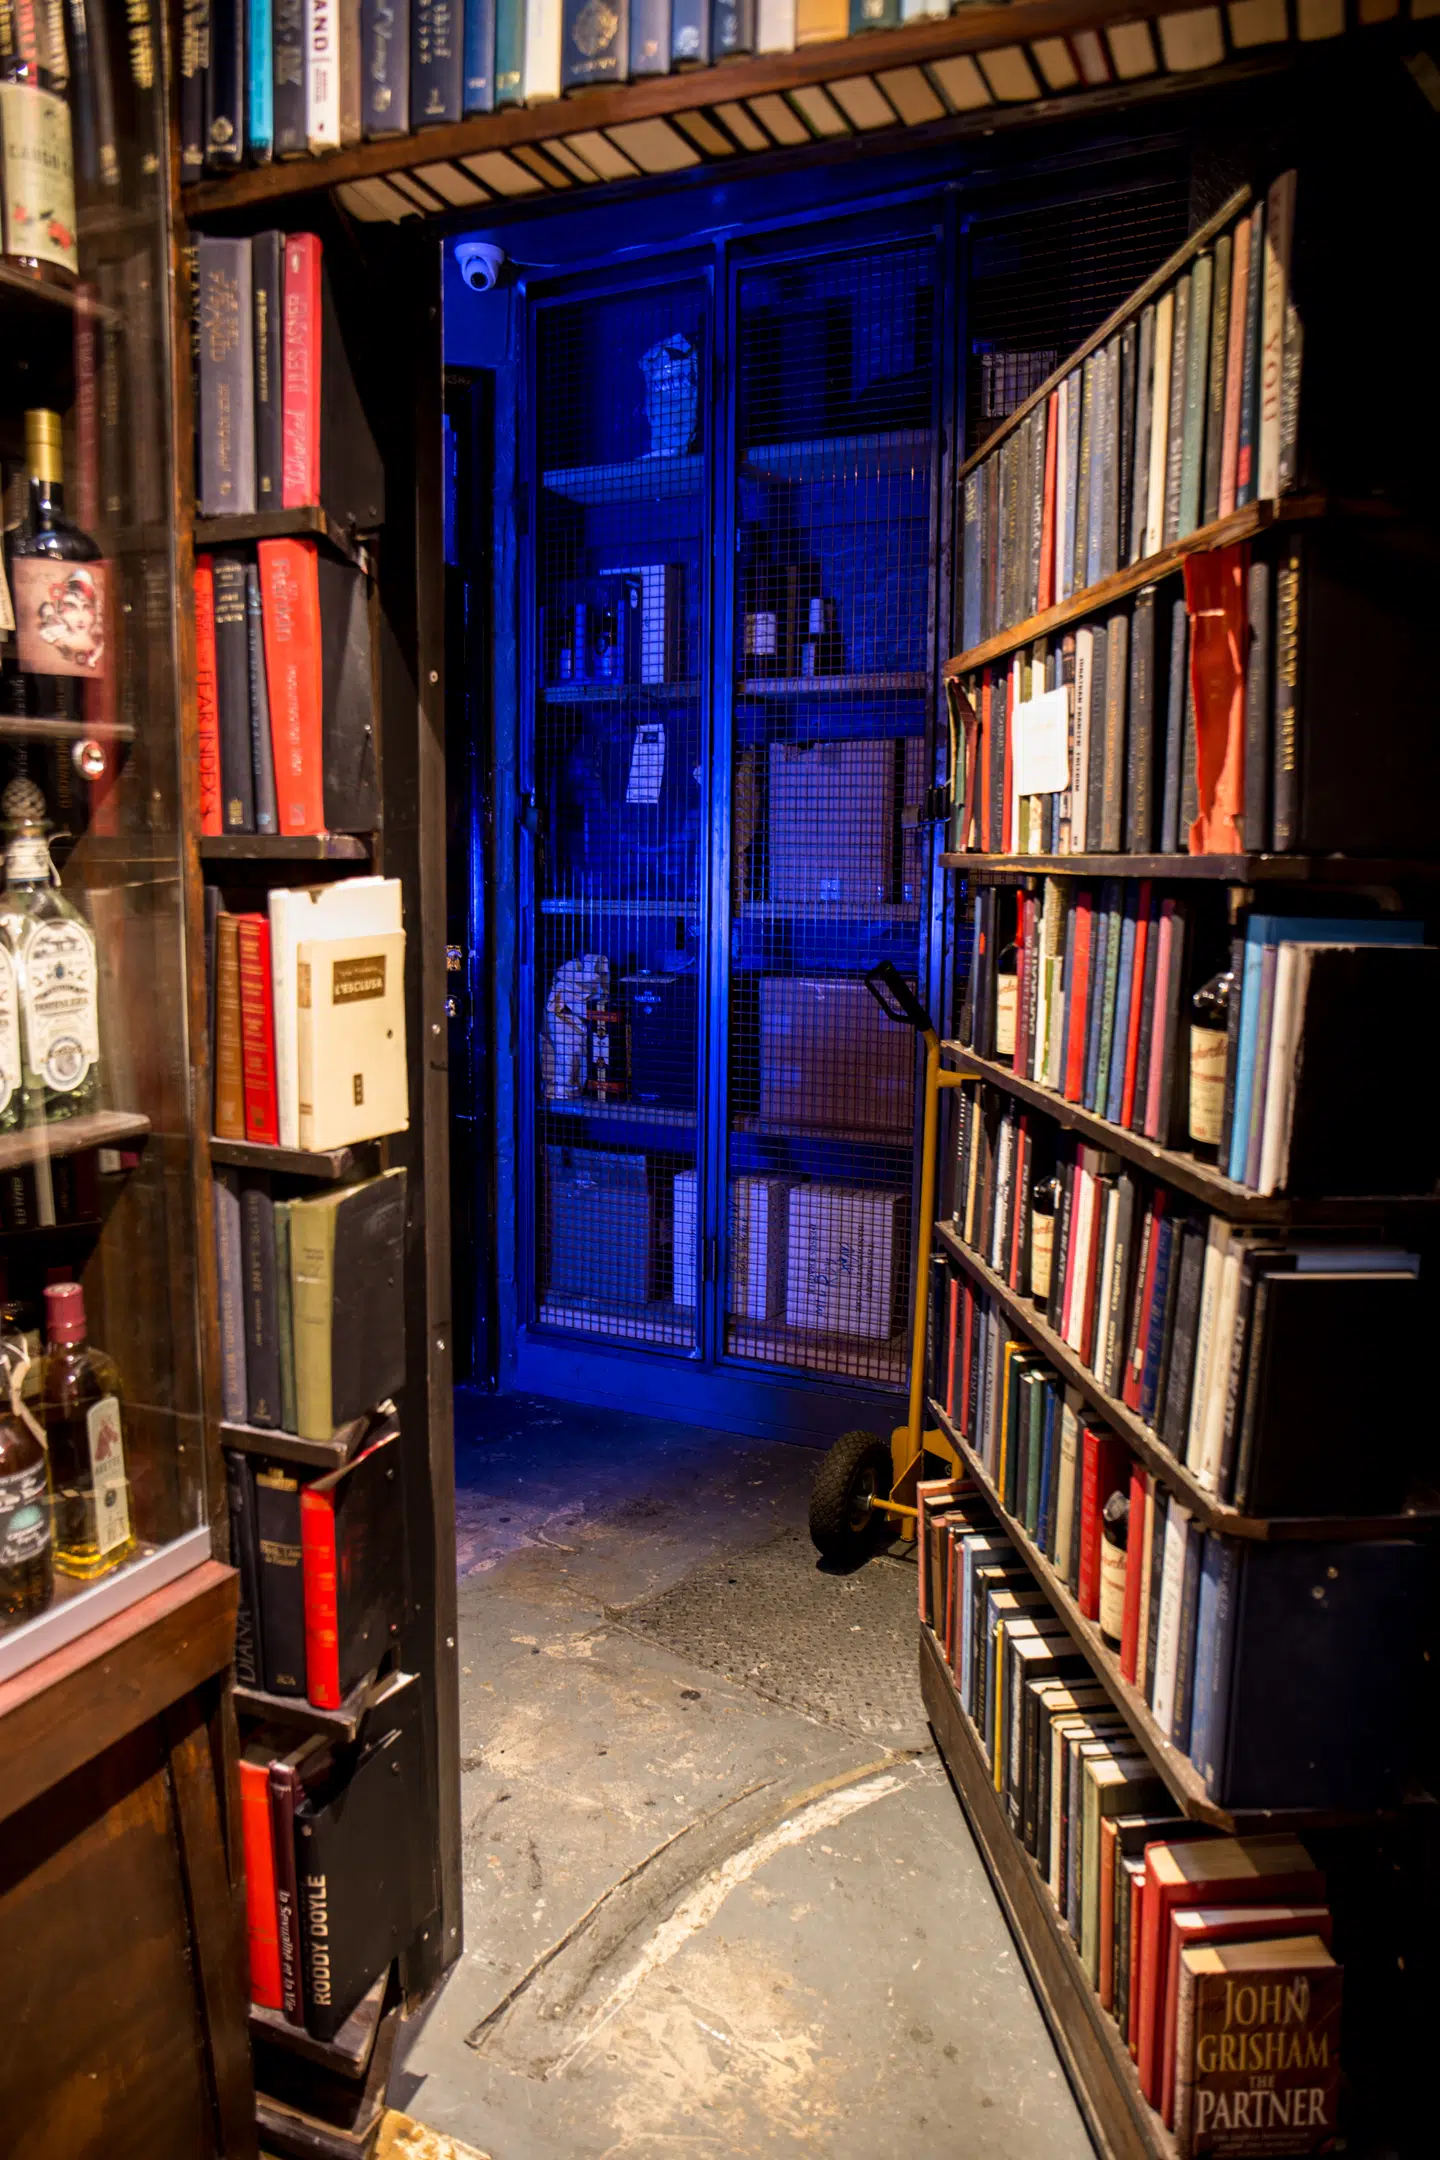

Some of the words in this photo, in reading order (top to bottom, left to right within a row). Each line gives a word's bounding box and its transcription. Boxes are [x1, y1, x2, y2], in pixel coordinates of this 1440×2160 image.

[285, 291, 308, 346] ASNER
[1261, 328, 1280, 422] YOU
[198, 669, 213, 722] FEAR
[198, 730, 216, 796] INDEX
[335, 978, 383, 996] L'ESCLUSA
[235, 1609, 257, 1683] DIANA
[279, 1889, 291, 1902] la
[307, 1873, 329, 1937] DOYLE
[311, 1942, 332, 2006] RODDY
[1223, 1979, 1307, 2031] JOHN
[1197, 2031, 1330, 2073] GRISHAM
[1248, 2074, 1276, 2088] THE
[1196, 2087, 1330, 2134] PARTNER
